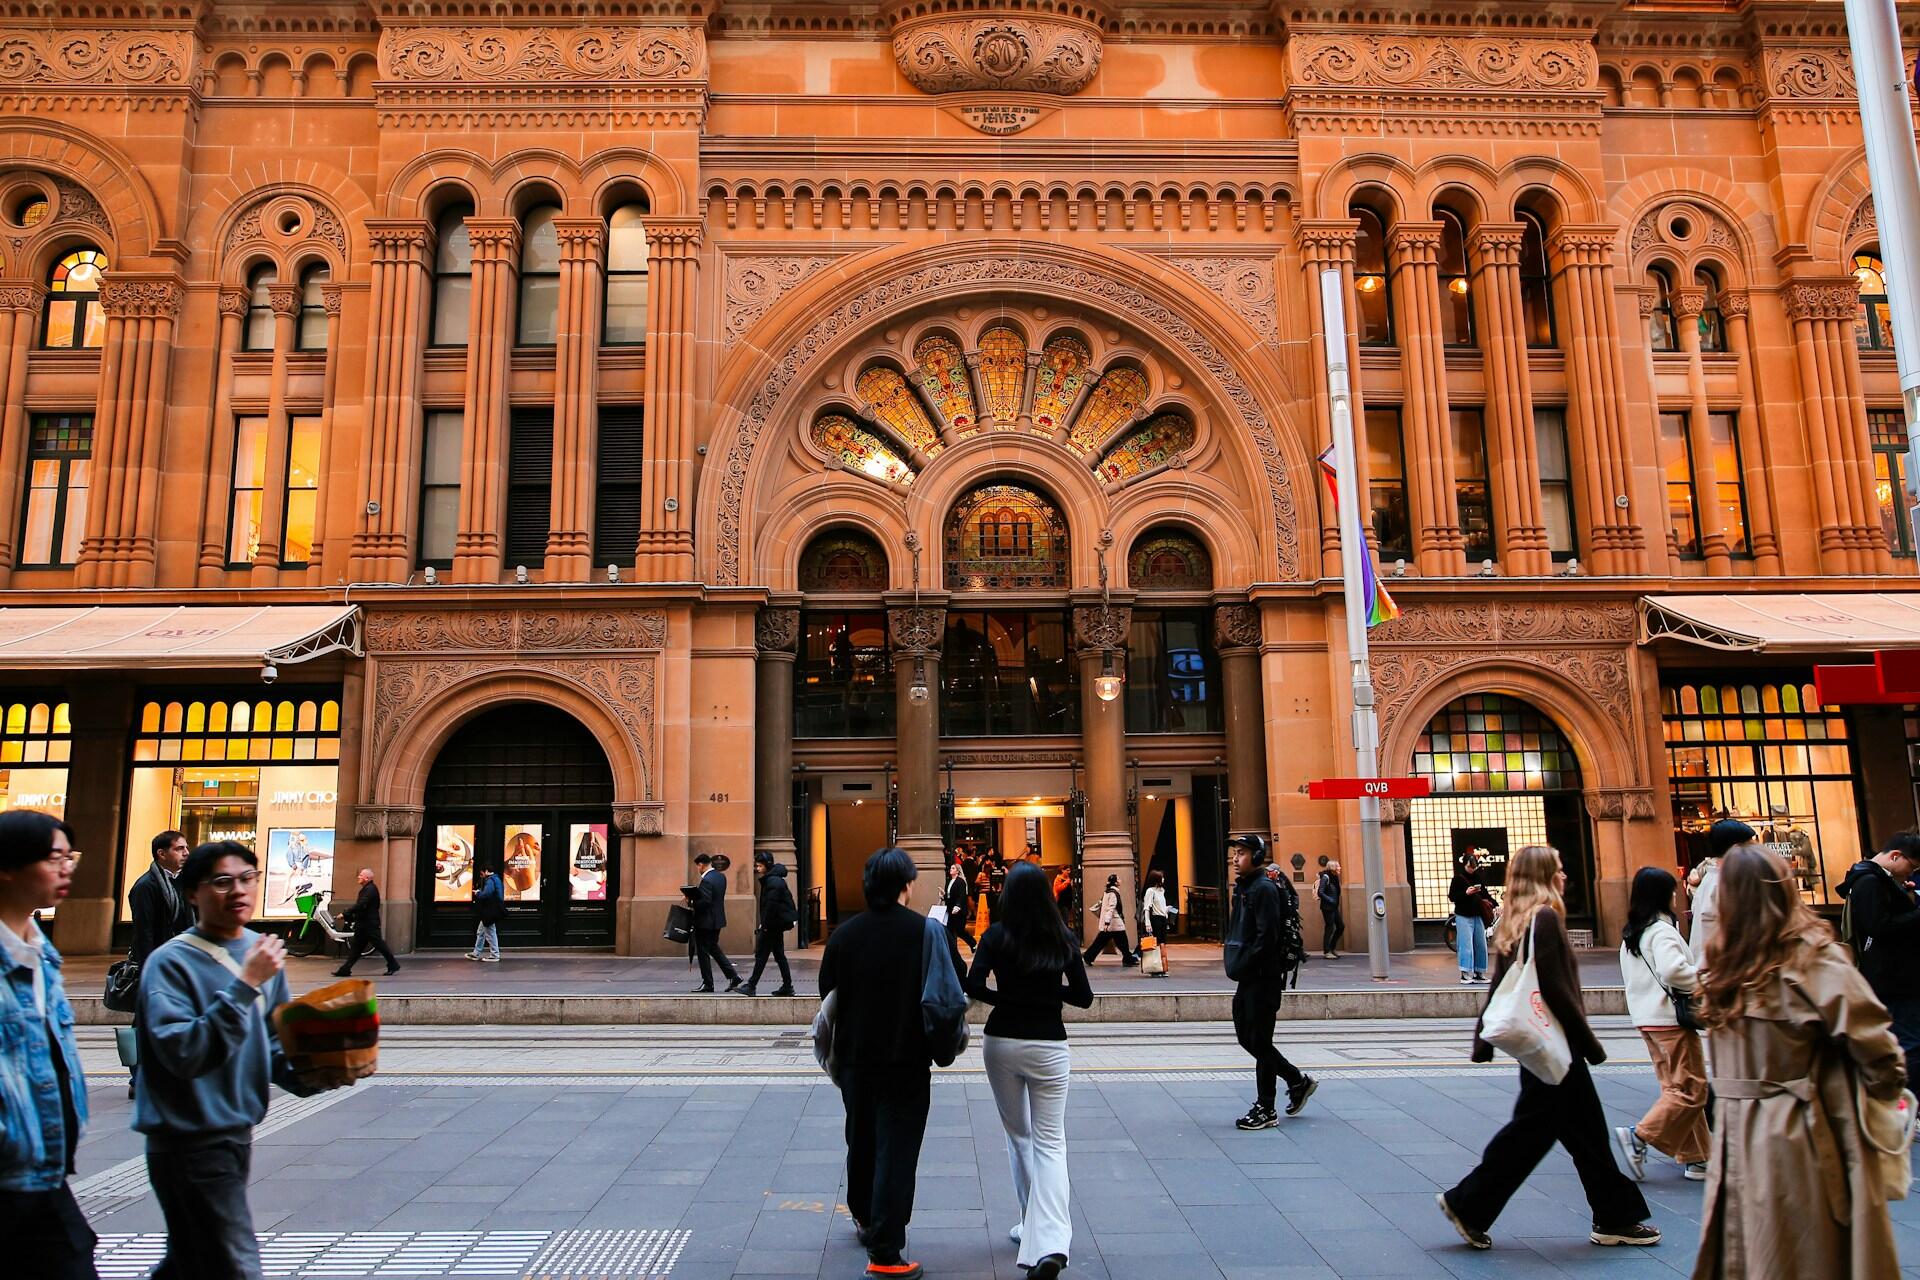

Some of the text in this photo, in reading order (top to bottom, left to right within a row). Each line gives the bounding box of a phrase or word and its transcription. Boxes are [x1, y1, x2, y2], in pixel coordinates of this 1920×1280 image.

[1365, 782, 1388, 795] QVB
[13, 793, 49, 806] JIMMY
[271, 791, 305, 804] JIMMY
[709, 792, 729, 803] 481
[1458, 854, 1506, 863] CACH
